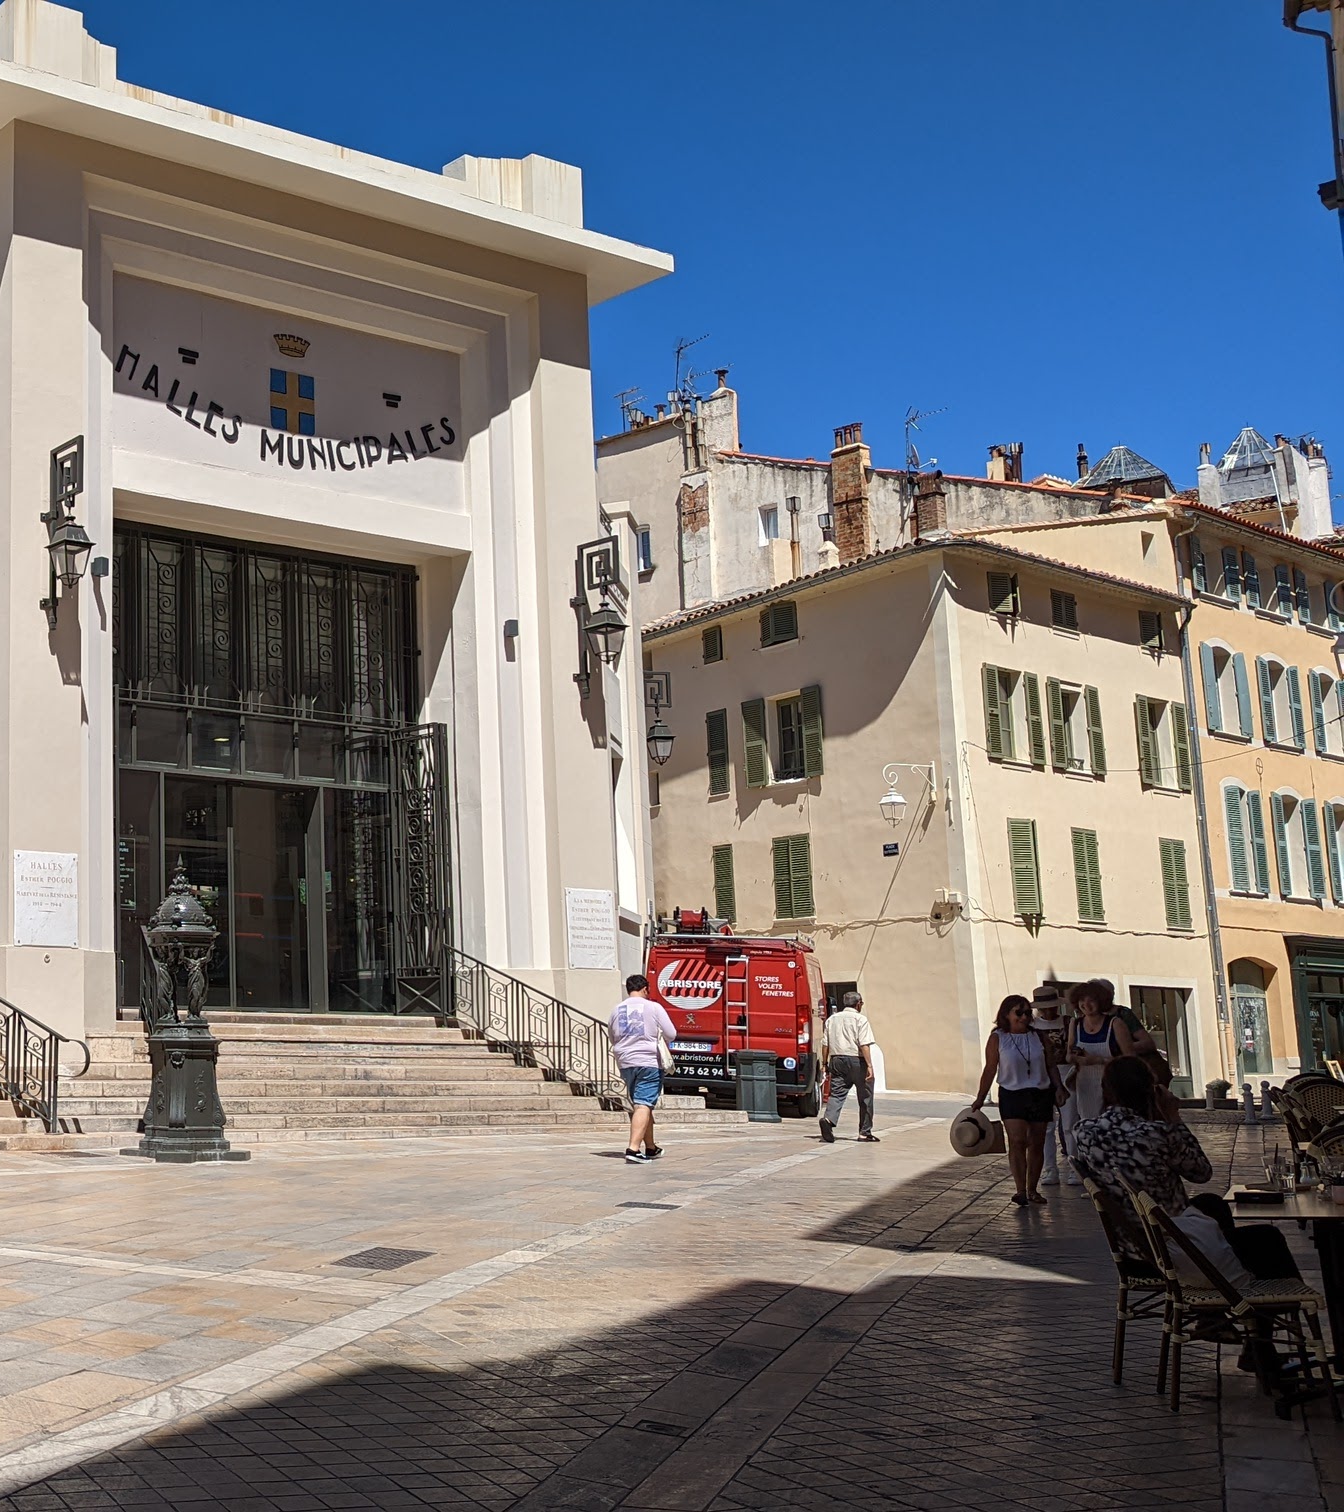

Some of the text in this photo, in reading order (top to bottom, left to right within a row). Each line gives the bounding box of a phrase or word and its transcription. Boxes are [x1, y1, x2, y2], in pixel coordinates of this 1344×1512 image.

[114, 343, 456, 472] HALLES MUNICIPALES
[30, 861, 63, 871] HALLES
[659, 979, 722, 989] ABRISTORE
[762, 990, 794, 998] FENETRES
[682, 1066, 695, 1075] 75
[697, 1067, 709, 1076] 62
[711, 1068, 724, 1077] 94
